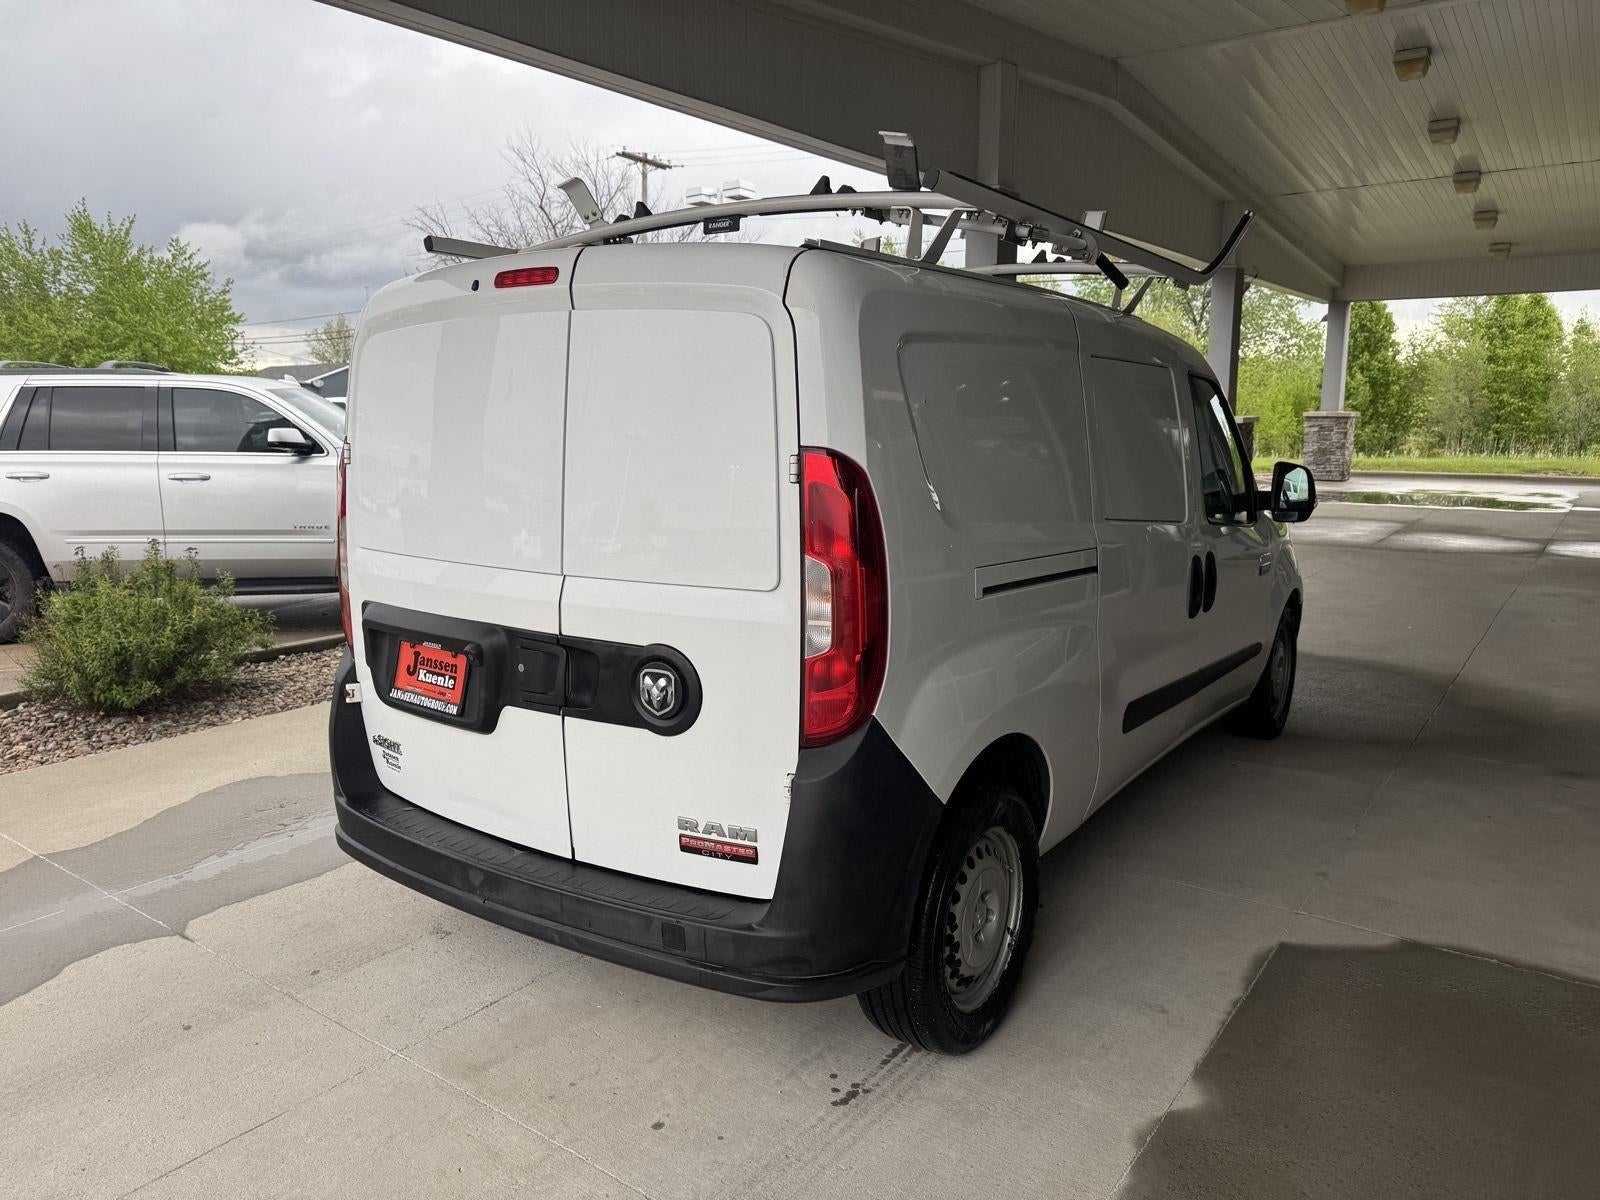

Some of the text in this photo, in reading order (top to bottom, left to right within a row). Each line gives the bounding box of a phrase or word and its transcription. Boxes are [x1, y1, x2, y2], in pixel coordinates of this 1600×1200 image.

[708, 221, 730, 229] RANGER
[406, 650, 458, 676] Janssen
[417, 668, 456, 689] Kuenle
[677, 815, 758, 843] RAM
[701, 849, 732, 860] CITY
